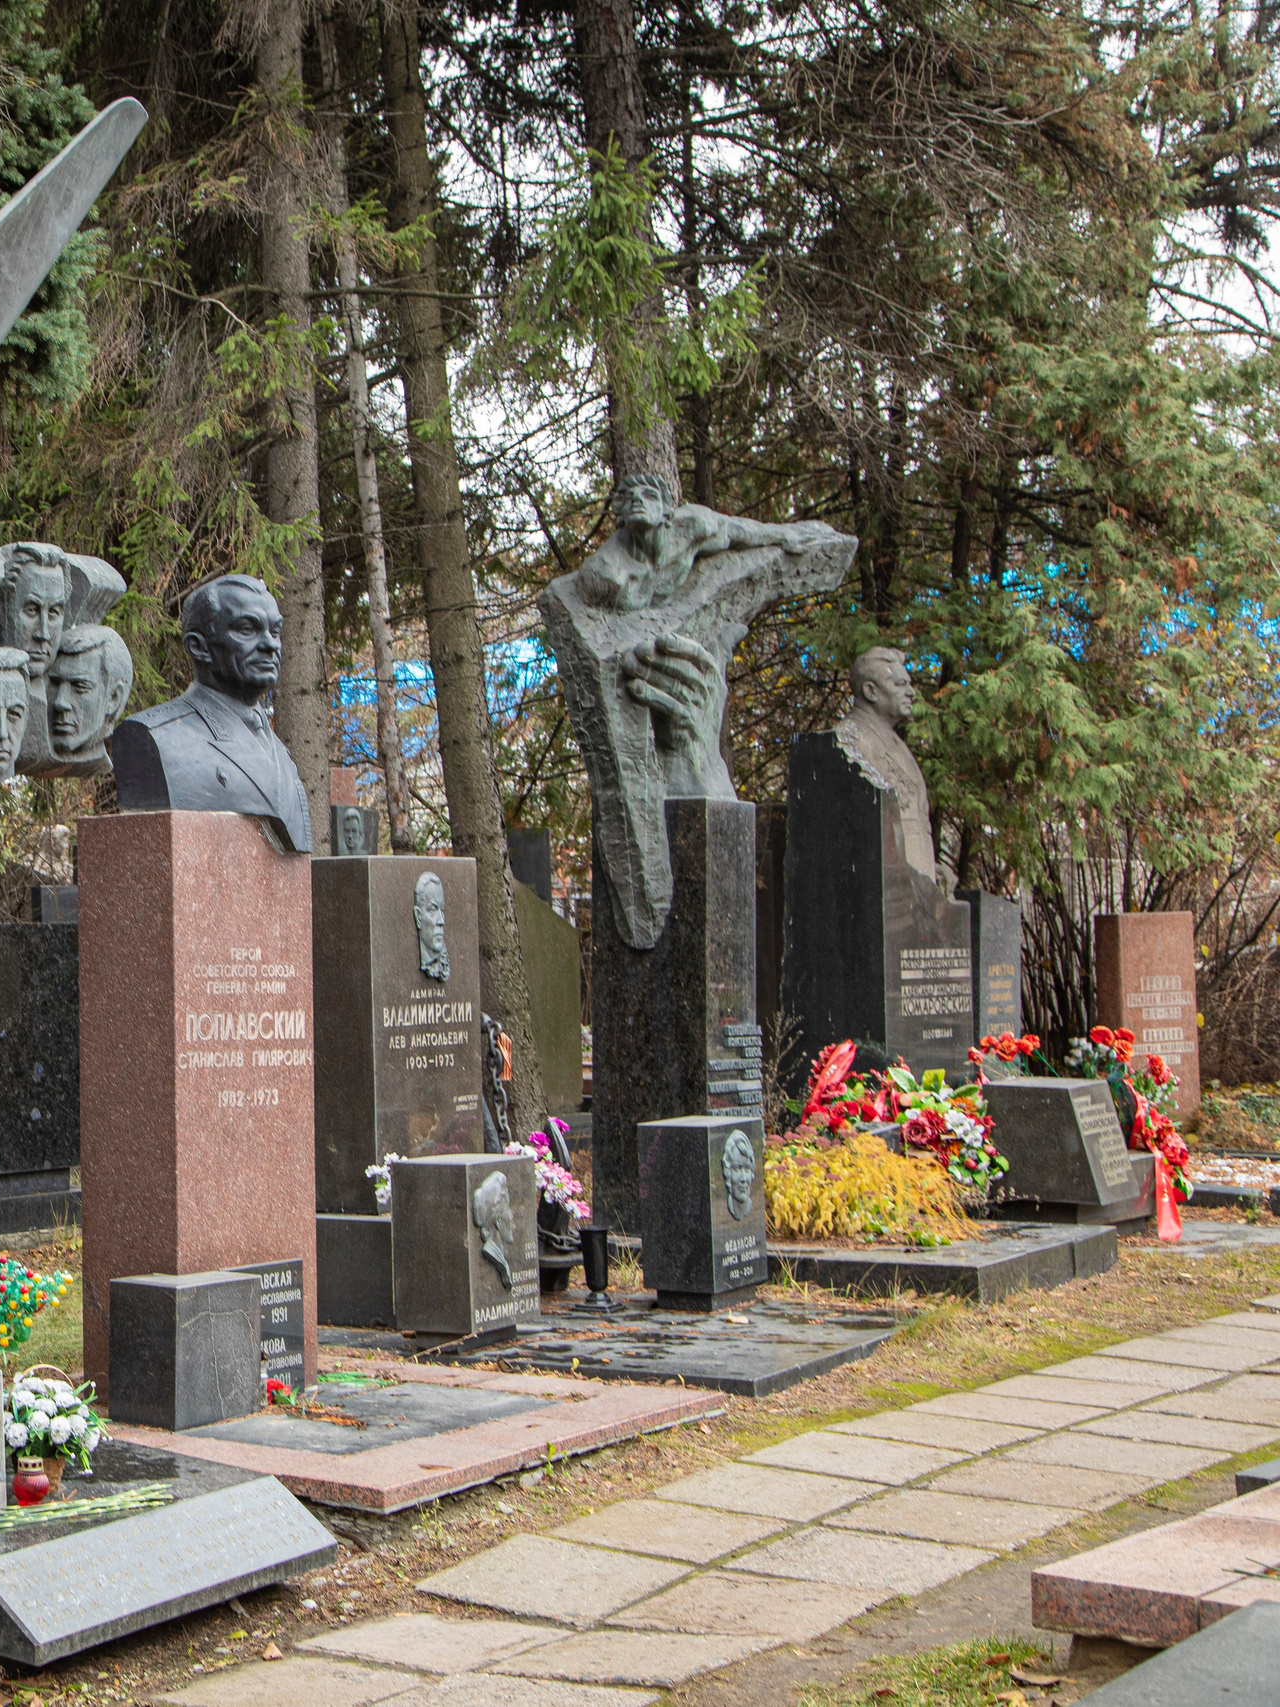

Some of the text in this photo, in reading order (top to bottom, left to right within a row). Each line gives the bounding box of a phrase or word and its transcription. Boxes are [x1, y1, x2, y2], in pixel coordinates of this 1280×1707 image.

[230, 946, 262, 961] ГЕРОЙ
[192, 964, 296, 978] СОВЕТСКОГО СОЮЗА
[207, 980, 287, 995] ГЕНЕРАЛ АРМИИ
[185, 1008, 306, 1042] ПОПЛАВСКИЙ
[389, 1030, 469, 1049] ЛЕВ АНАТОЛЬЕВИЧ
[177, 1049, 313, 1069] СТАНИСЛАВ ГИЛЯРОВИЧ
[406, 1053, 455, 1070] 1903-1973
[724, 1235, 757, 1252] ФЕДУЛОВА
[271, 1306, 288, 1324] 1991
[475, 1297, 539, 1324] ВЛАДИМИРСКАЯ
[266, 1353, 303, 1371] славовна
